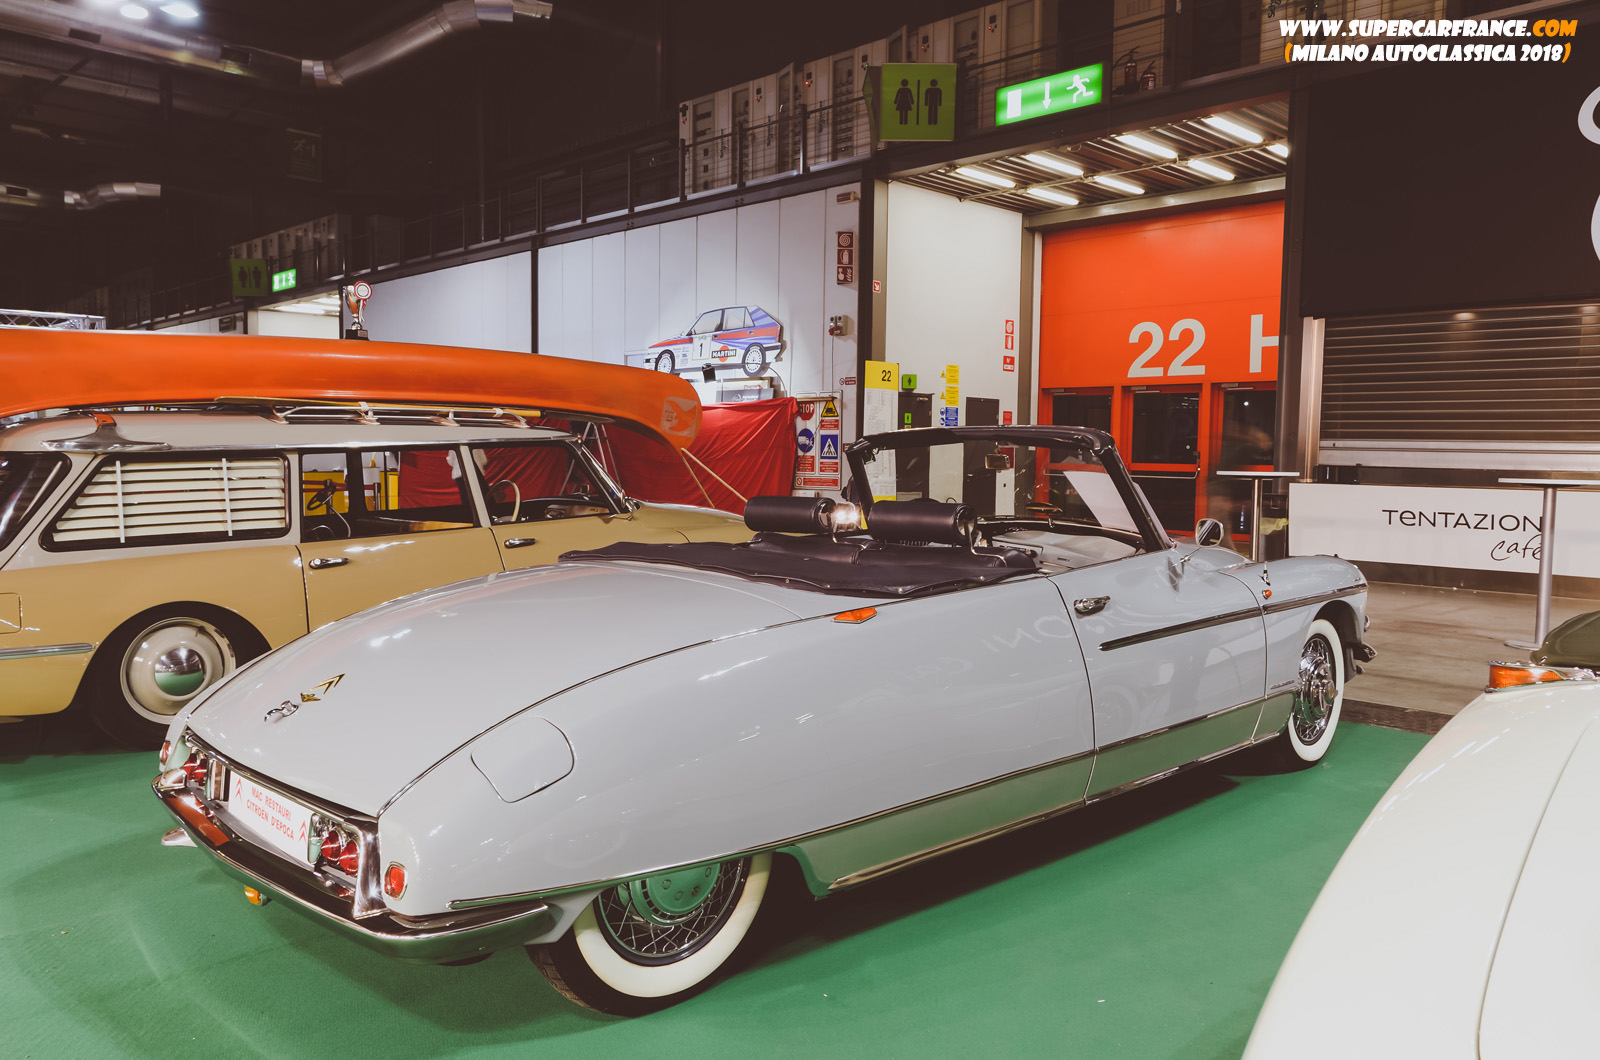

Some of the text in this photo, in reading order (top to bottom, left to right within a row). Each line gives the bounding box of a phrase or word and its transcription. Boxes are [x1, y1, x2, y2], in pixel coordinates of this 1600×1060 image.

[712, 349, 736, 359] MARTINI
[1127, 318, 1206, 379] 22
[881, 369, 892, 382] 22
[799, 403, 815, 414] STOP
[252, 786, 291, 822] MAC RESTAURI
[271, 816, 294, 840] D'EPOCA
